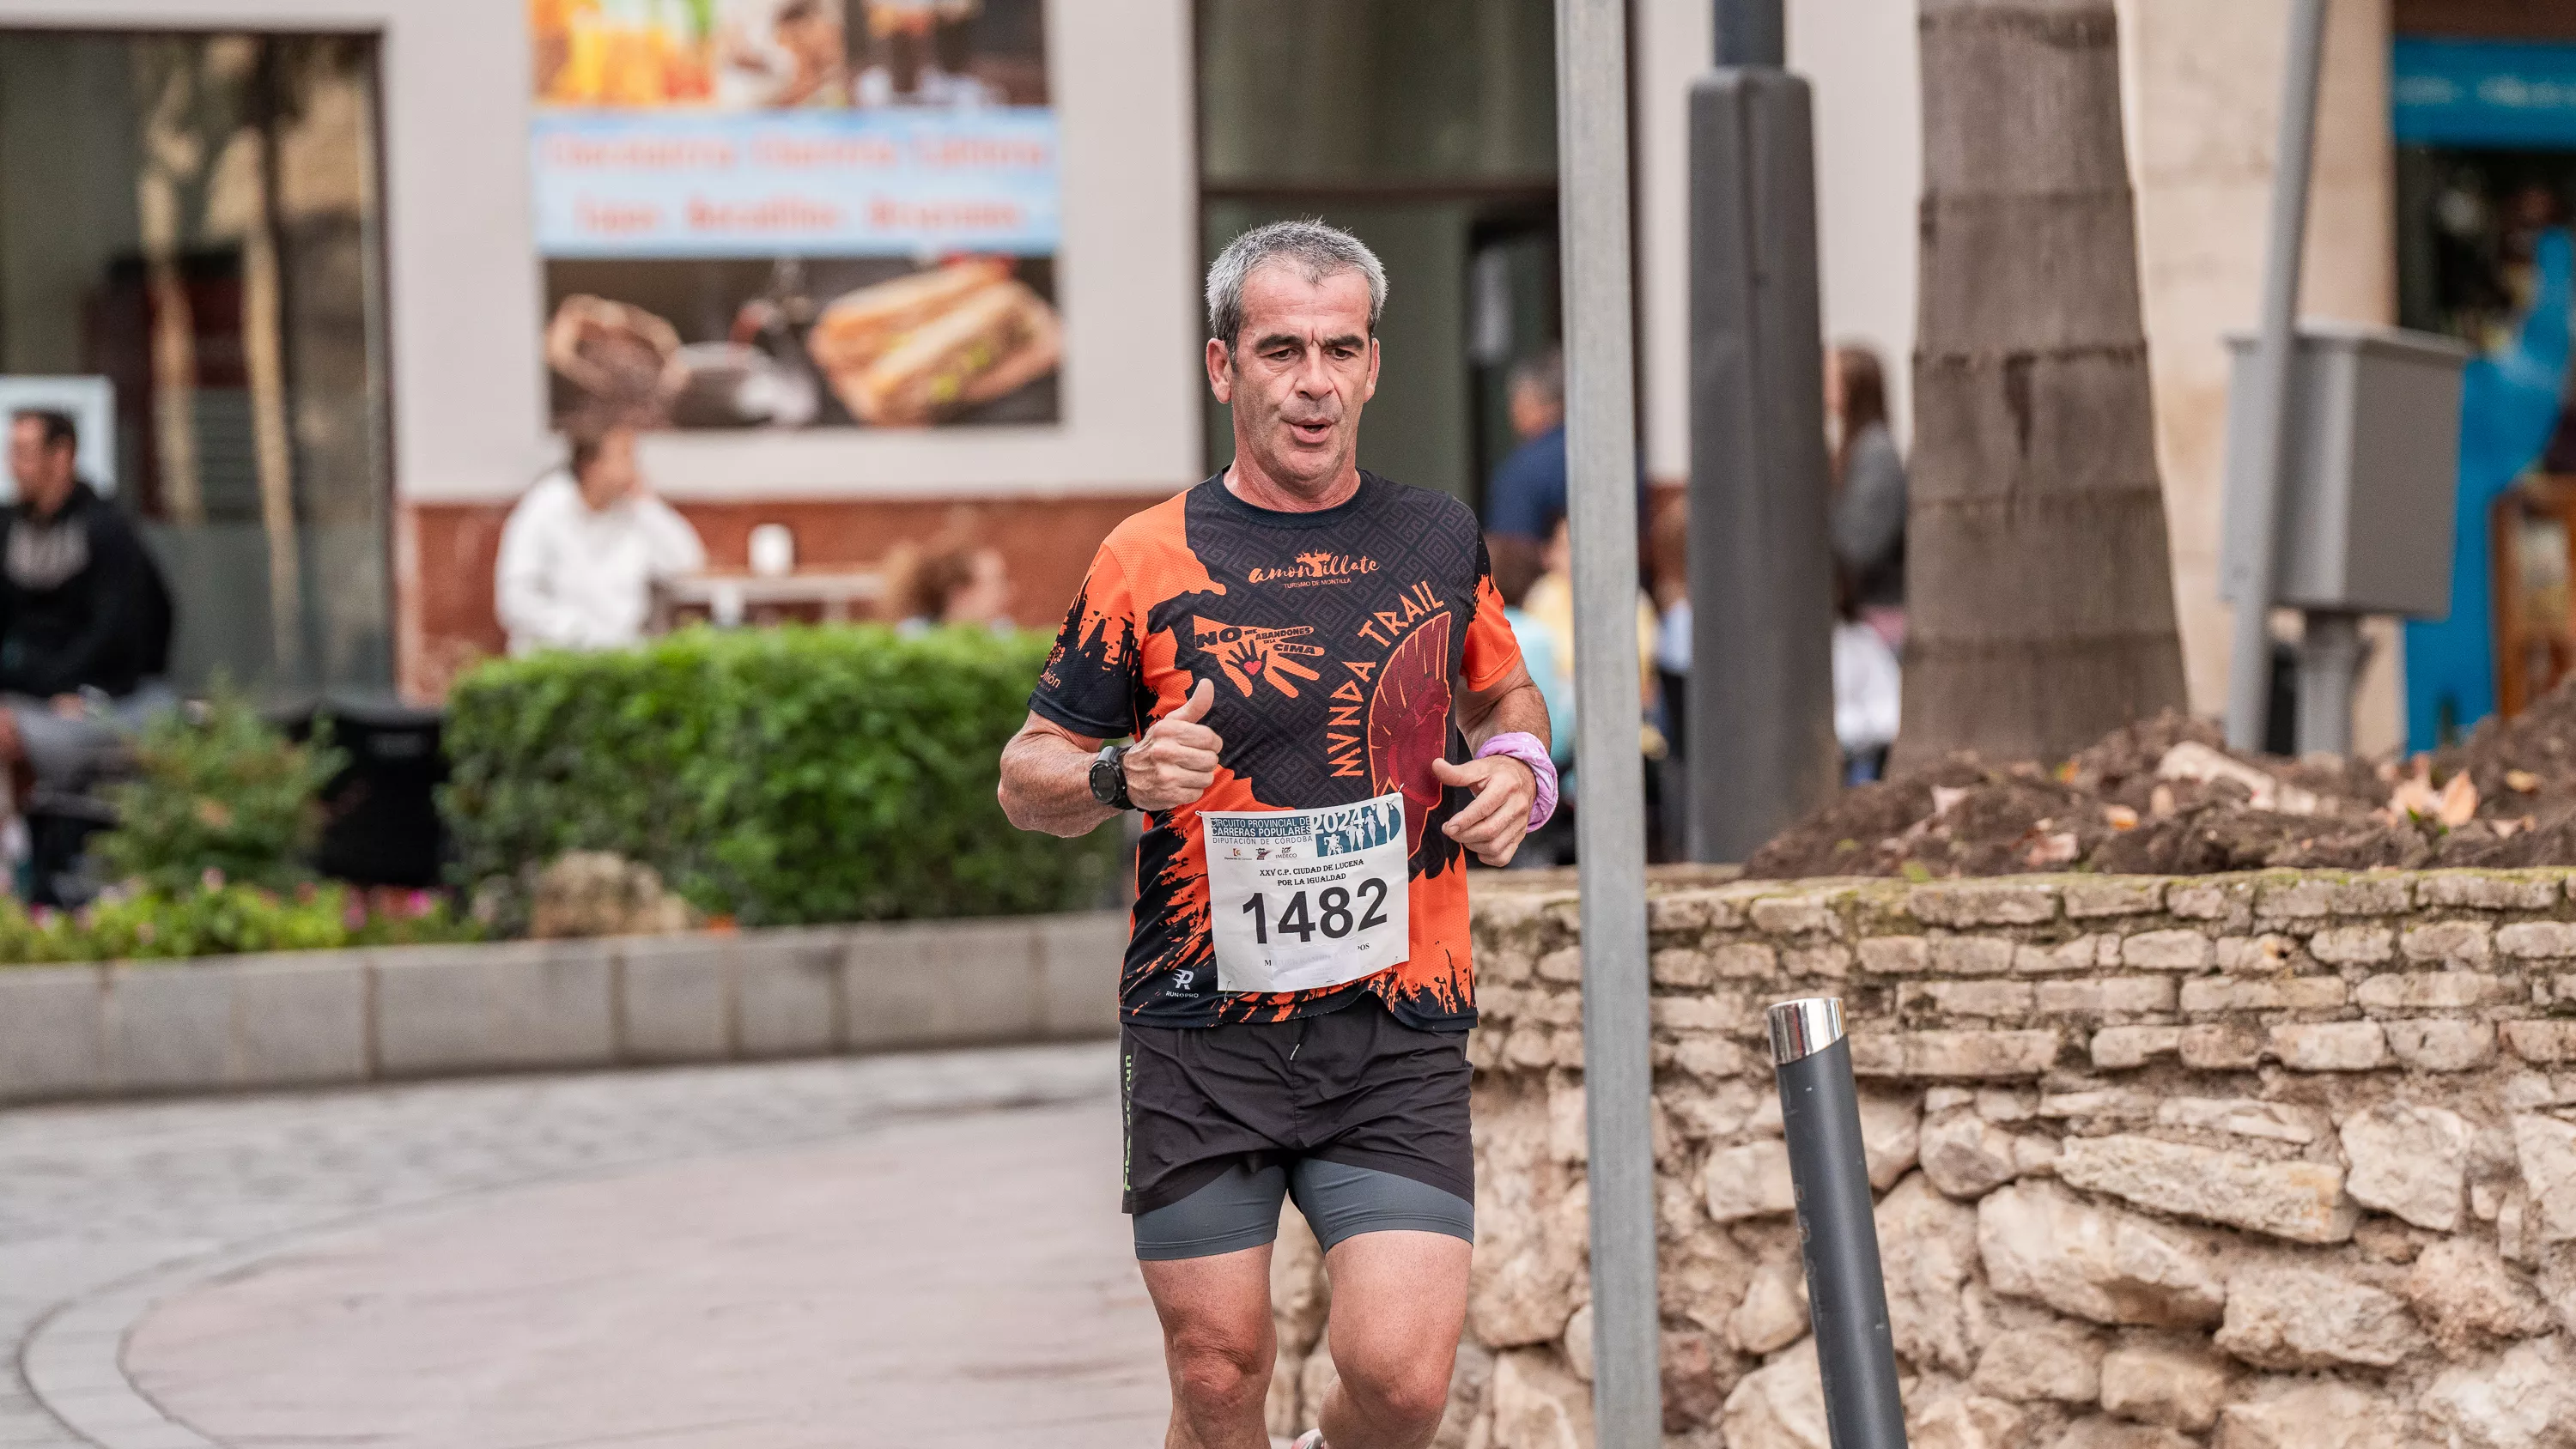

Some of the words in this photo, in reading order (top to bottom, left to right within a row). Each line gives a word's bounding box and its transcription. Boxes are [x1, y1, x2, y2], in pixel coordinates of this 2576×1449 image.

[1357, 580, 1445, 648] TRAIL
[1195, 627, 1242, 648] NO
[1255, 627, 1311, 640] ABANDONES
[1273, 644, 1315, 655] CIMA
[1211, 817, 1246, 828] CIRCUITO
[1247, 817, 1299, 828] PROVINCIAL
[1299, 816, 1310, 826] DE
[1313, 809, 1365, 835] 2024
[1212, 828, 1256, 838] CARRERAS
[1258, 825, 1312, 837] POPULARES
[1212, 836, 1256, 846] DIPUTACIÓN
[1274, 835, 1313, 845] CÓRDOBA
[1260, 869, 1276, 877] XXV
[1277, 867, 1291, 876] C.P.
[1293, 865, 1321, 875] CIUDAD
[1323, 864, 1334, 872] DE
[1335, 859, 1364, 870] LUCENA
[1277, 878, 1293, 887] POR
[1294, 877, 1305, 886] LA
[1307, 873, 1347, 884] IGUALDAD
[1242, 877, 1388, 944] 1482
